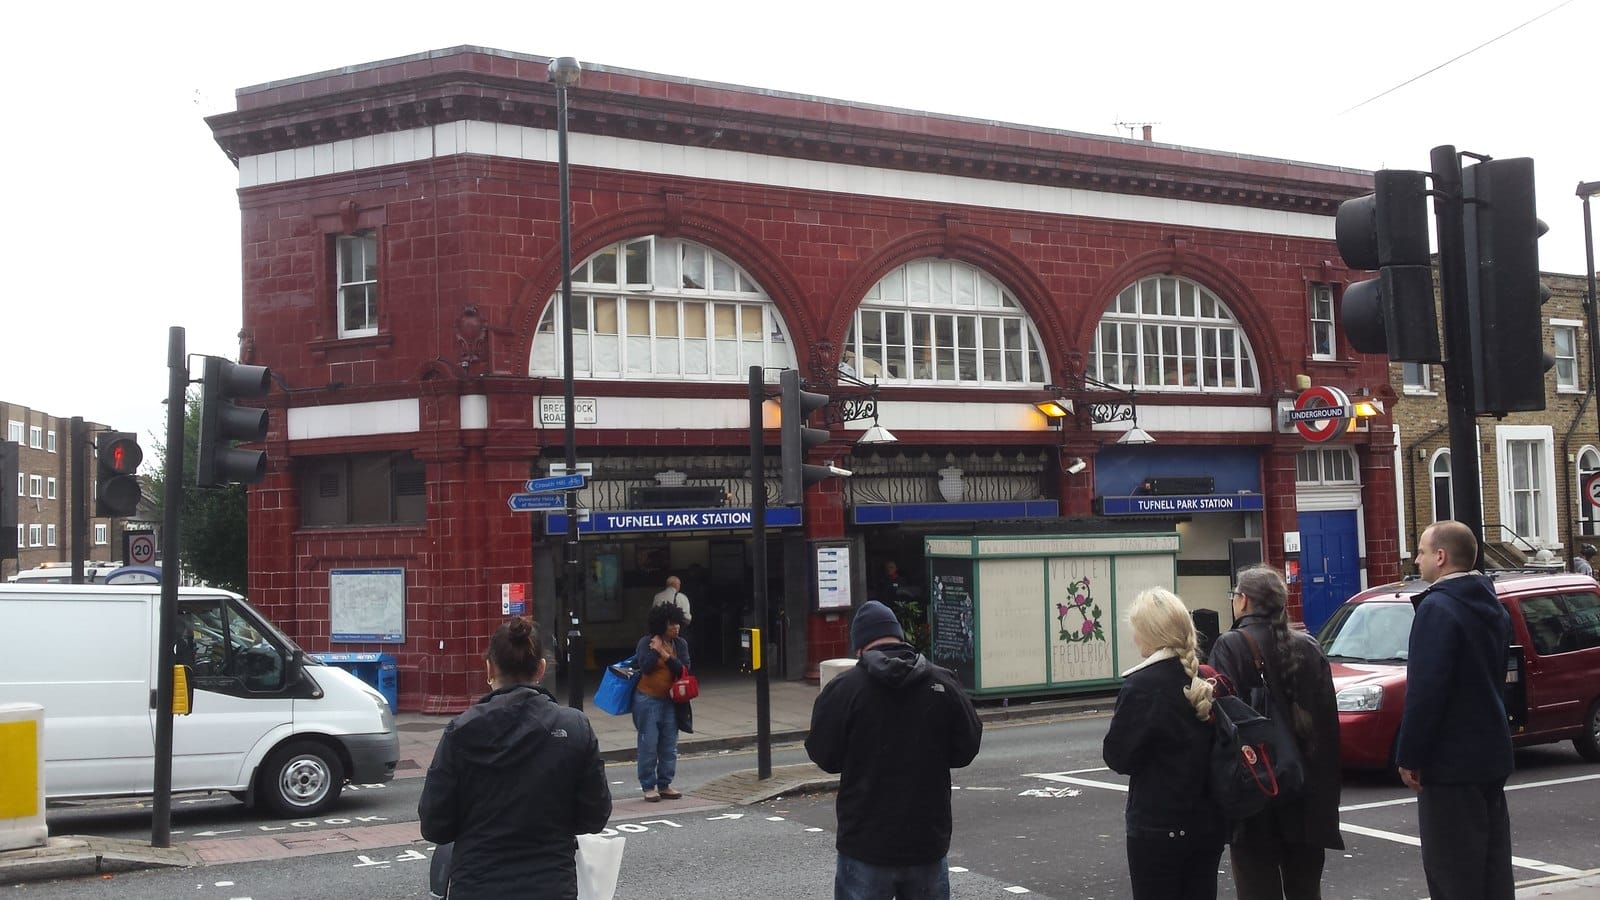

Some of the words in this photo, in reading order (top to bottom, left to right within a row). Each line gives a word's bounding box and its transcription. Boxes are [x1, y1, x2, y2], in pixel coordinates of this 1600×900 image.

[544, 404, 593, 413] BRECOCK
[1291, 408, 1343, 419] UNDERGROUND
[544, 413, 566, 421] ROAD
[1138, 500, 1175, 510] TUFNELL
[1177, 499, 1198, 509] PARK
[1200, 498, 1233, 508] STATION
[608, 515, 663, 528] TUFNELL
[667, 514, 698, 526] PARK
[702, 512, 750, 525] STATION
[134, 544, 150, 556] 20
[1052, 558, 1108, 580] VIOLET
[1053, 643, 1112, 668] FREDERICK
[258, 816, 389, 831] LOOK
[600, 819, 683, 837] LOO
